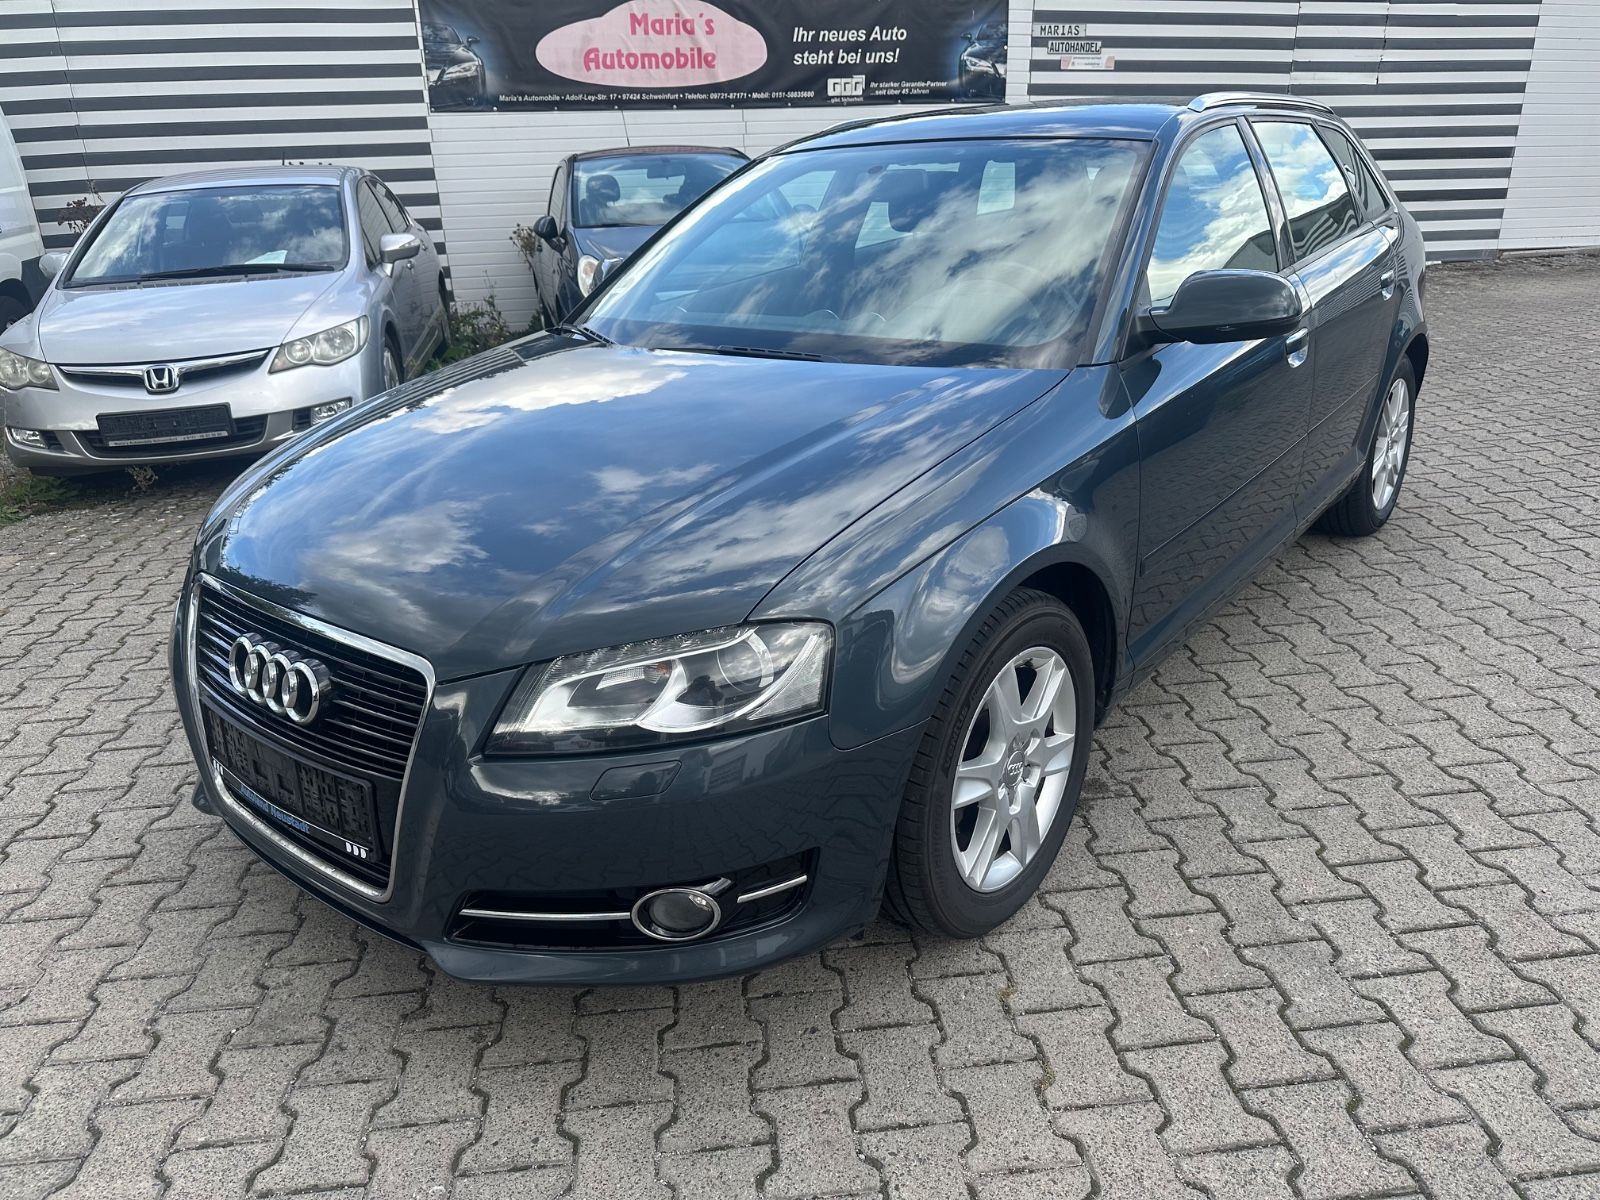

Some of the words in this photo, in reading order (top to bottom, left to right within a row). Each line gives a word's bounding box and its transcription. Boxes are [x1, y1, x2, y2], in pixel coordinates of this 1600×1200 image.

[793, 26, 815, 43] Ihr
[819, 29, 866, 42] neues
[869, 25, 908, 42] Auto
[1040, 25, 1080, 36] MARIAS
[1049, 41, 1100, 53] AUTOHANDEL
[583, 47, 717, 72] Automobile
[793, 50, 834, 65] steht
[838, 49, 861, 64] bei
[866, 48, 900, 64] uns!
[901, 80, 948, 88] Garantie-Partner
[565, 94, 608, 102] Adolf-Ley-Str.
